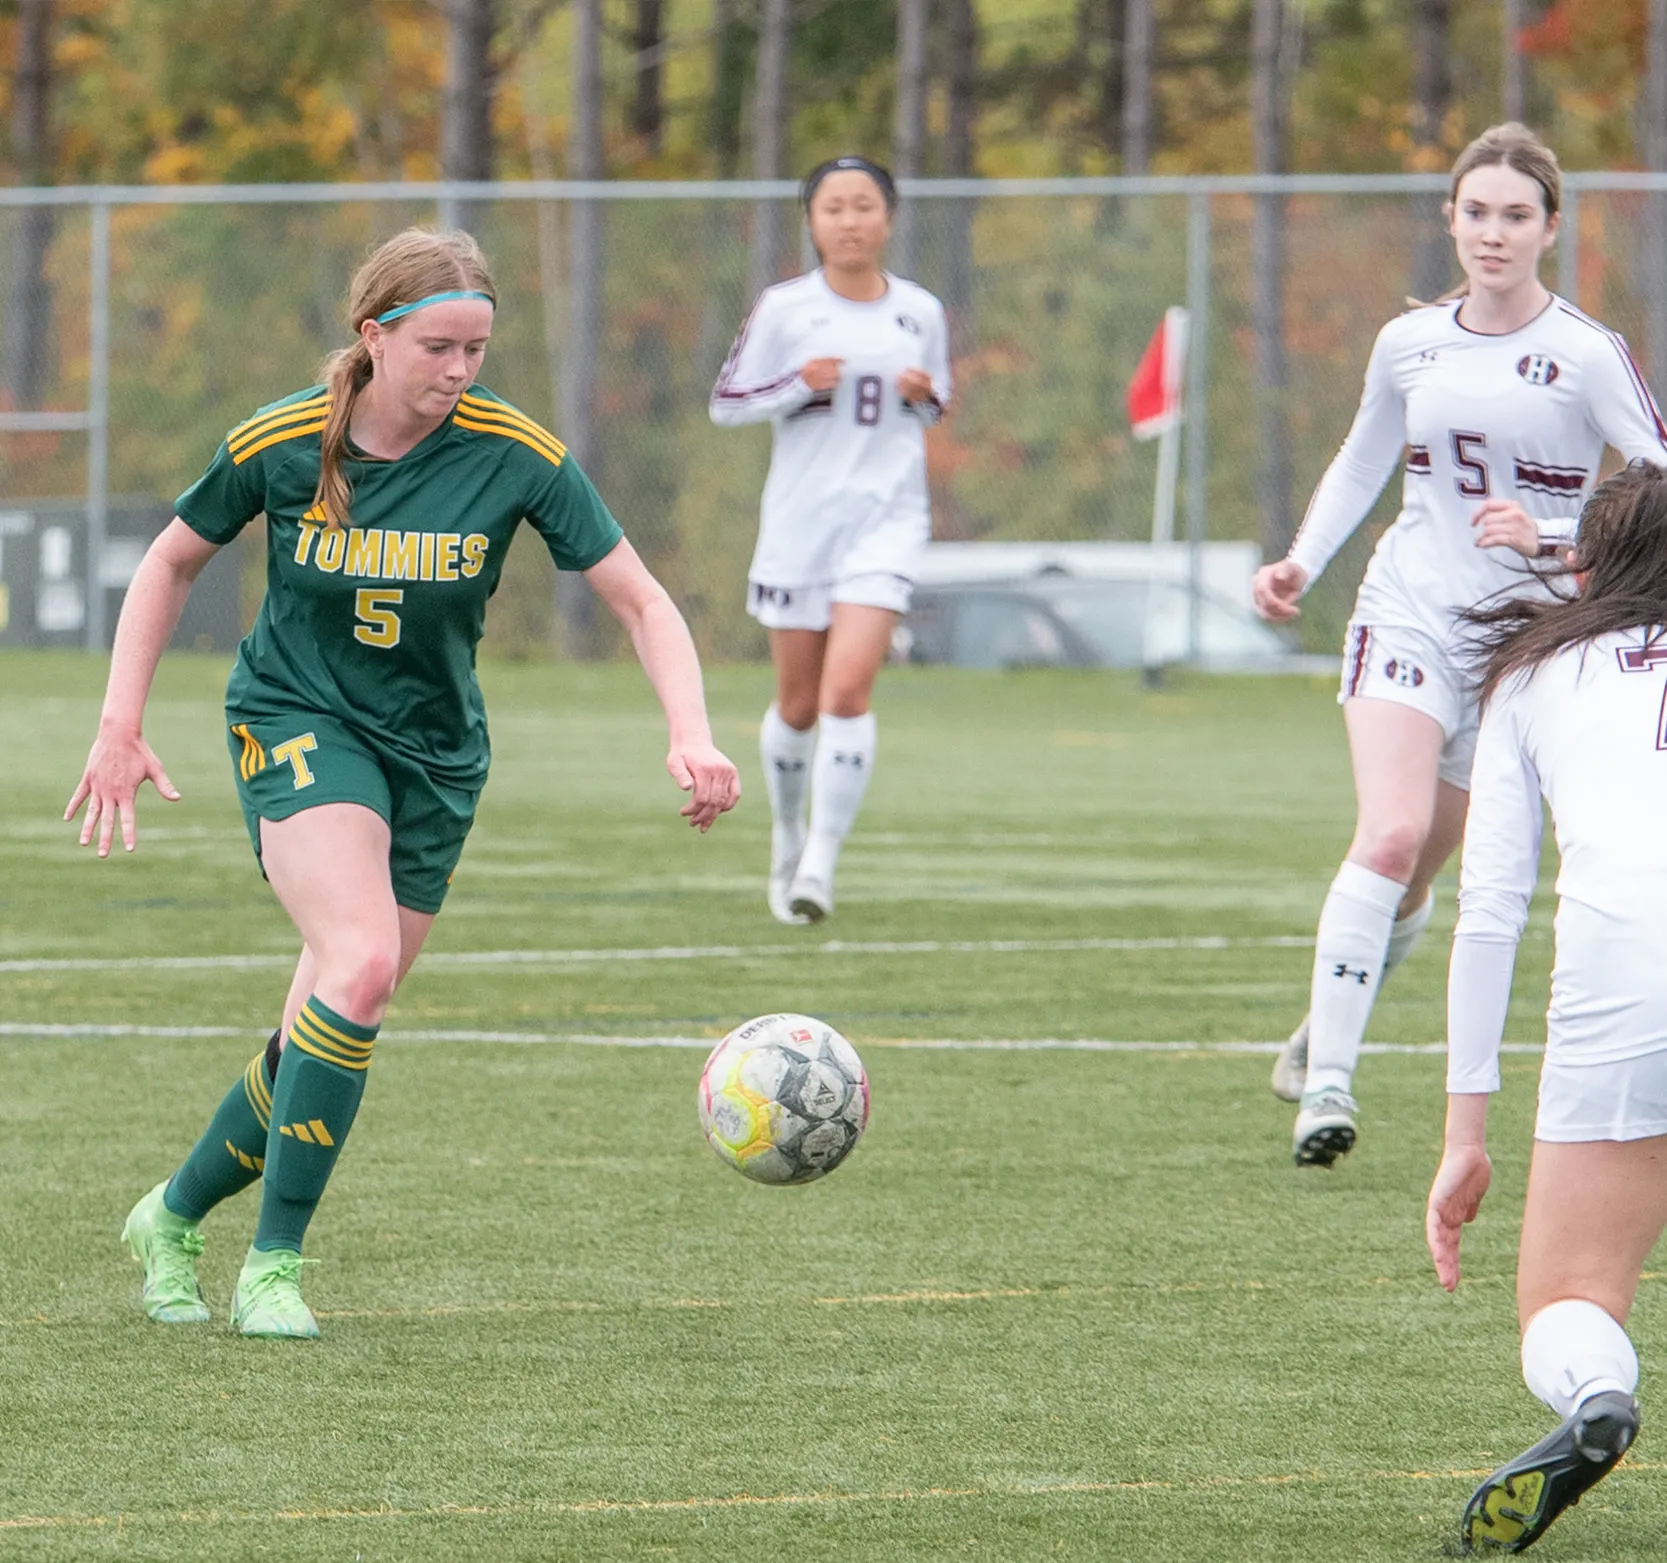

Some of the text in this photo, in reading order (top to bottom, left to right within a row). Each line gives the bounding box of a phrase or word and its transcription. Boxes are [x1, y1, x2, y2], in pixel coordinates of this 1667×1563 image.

[855, 375, 882, 426] 8
[1448, 428, 1491, 500] 5
[294, 519, 490, 582] TOMMIES
[353, 588, 404, 649] 5
[271, 732, 319, 791] T
